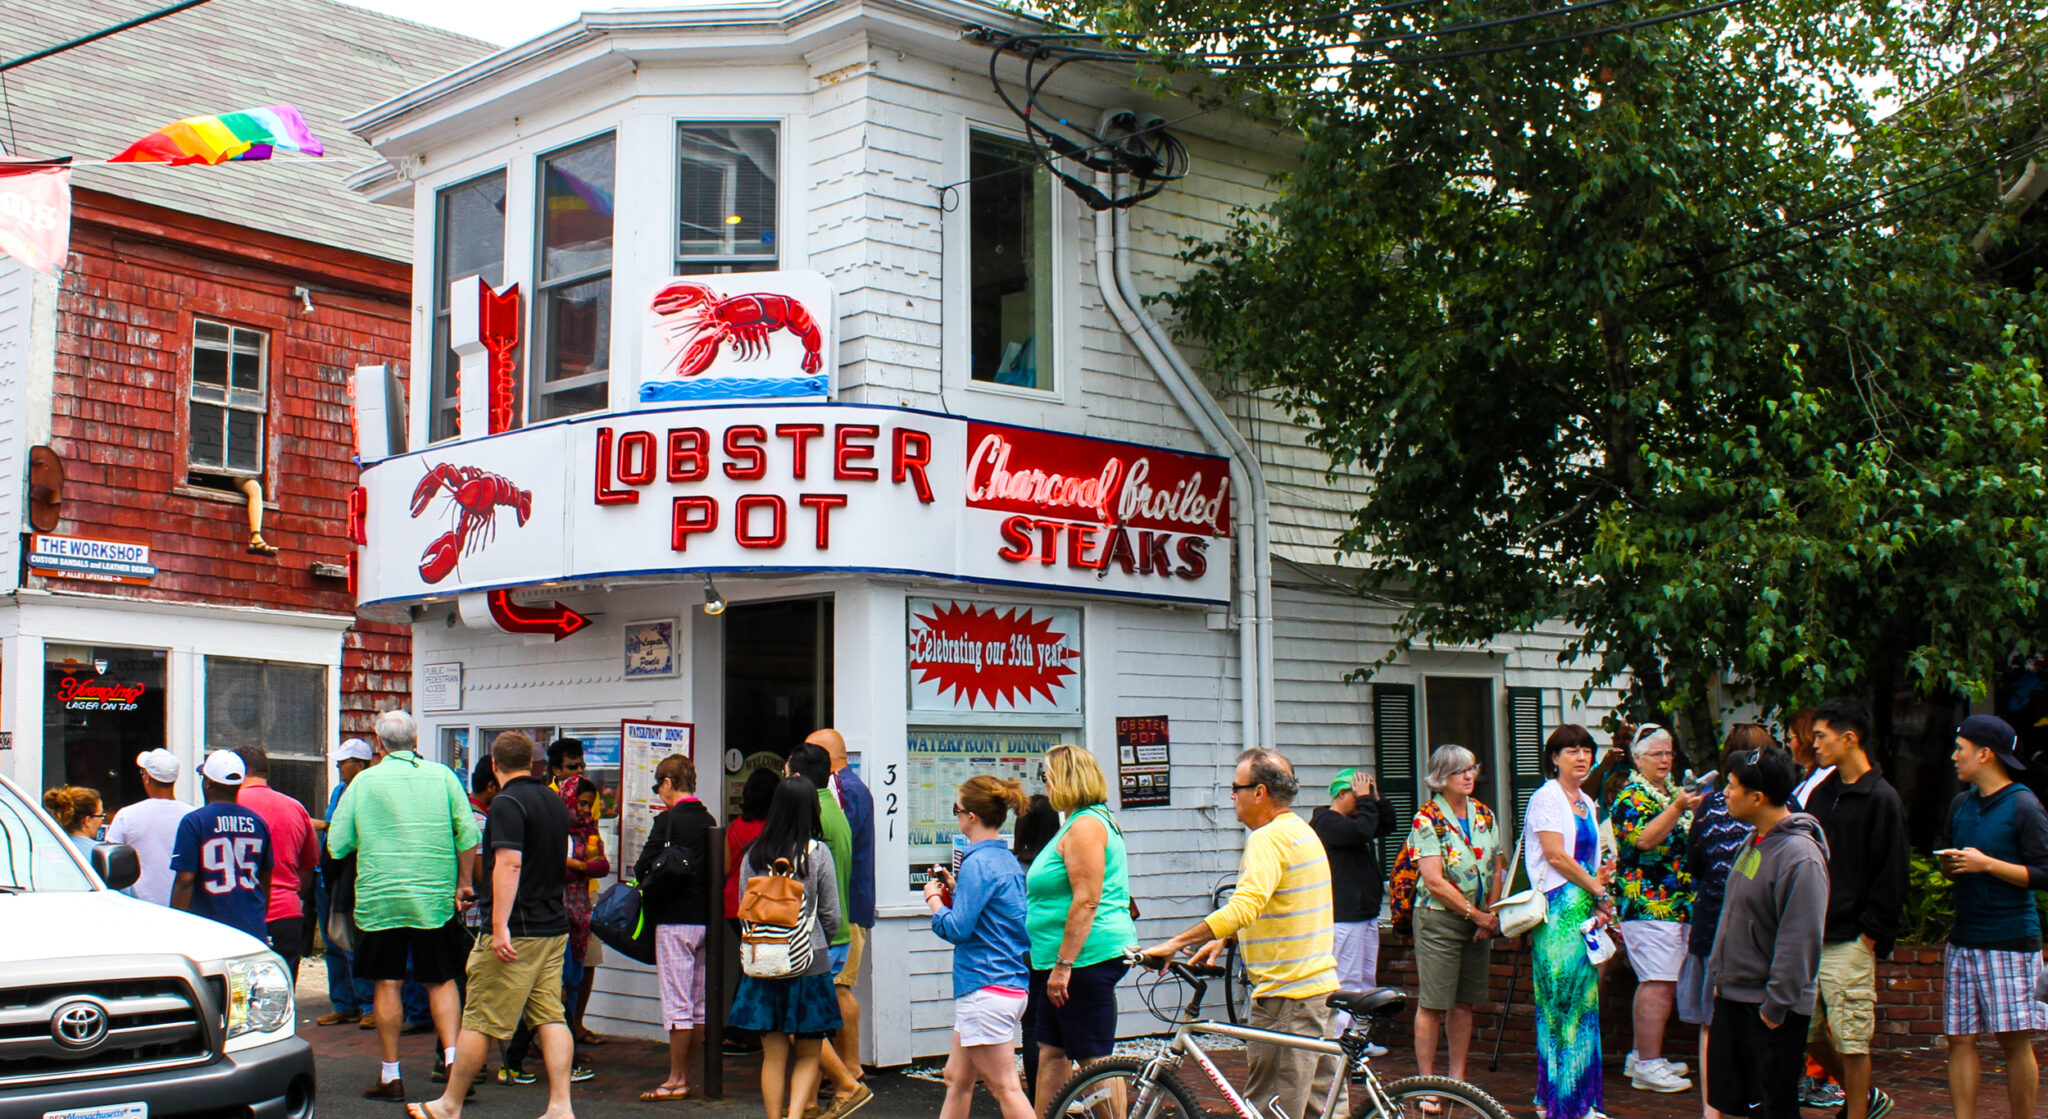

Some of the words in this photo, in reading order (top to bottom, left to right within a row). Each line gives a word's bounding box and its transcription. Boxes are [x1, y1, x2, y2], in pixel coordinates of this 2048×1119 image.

[594, 423, 935, 506] LOBSTER
[966, 434, 1123, 525] Charcoal
[671, 493, 848, 551] POT
[30, 554, 59, 565] CUSTOM
[59, 557, 89, 569] SANDALS
[90, 561, 101, 569] and
[102, 563, 130, 572] LEATHER
[131, 564, 155, 575] DESIGN
[41, 538, 68, 555] THE
[70, 541, 143, 561] WORKSHOP
[998, 515, 1210, 580] STEAKS
[915, 627, 982, 674] Celebrating
[986, 641, 1006, 665] our
[1008, 633, 1034, 666] 35th
[66, 701, 100, 711] LAGER
[101, 702, 117, 711] ON
[119, 703, 138, 711] TAP
[628, 726, 662, 740] WATERFRONT
[907, 732, 1003, 753] WATERFRONT
[1130, 732, 1157, 744] POT
[883, 764, 898, 842] 321
[214, 815, 255, 834] JONES
[202, 836, 263, 895] 95
